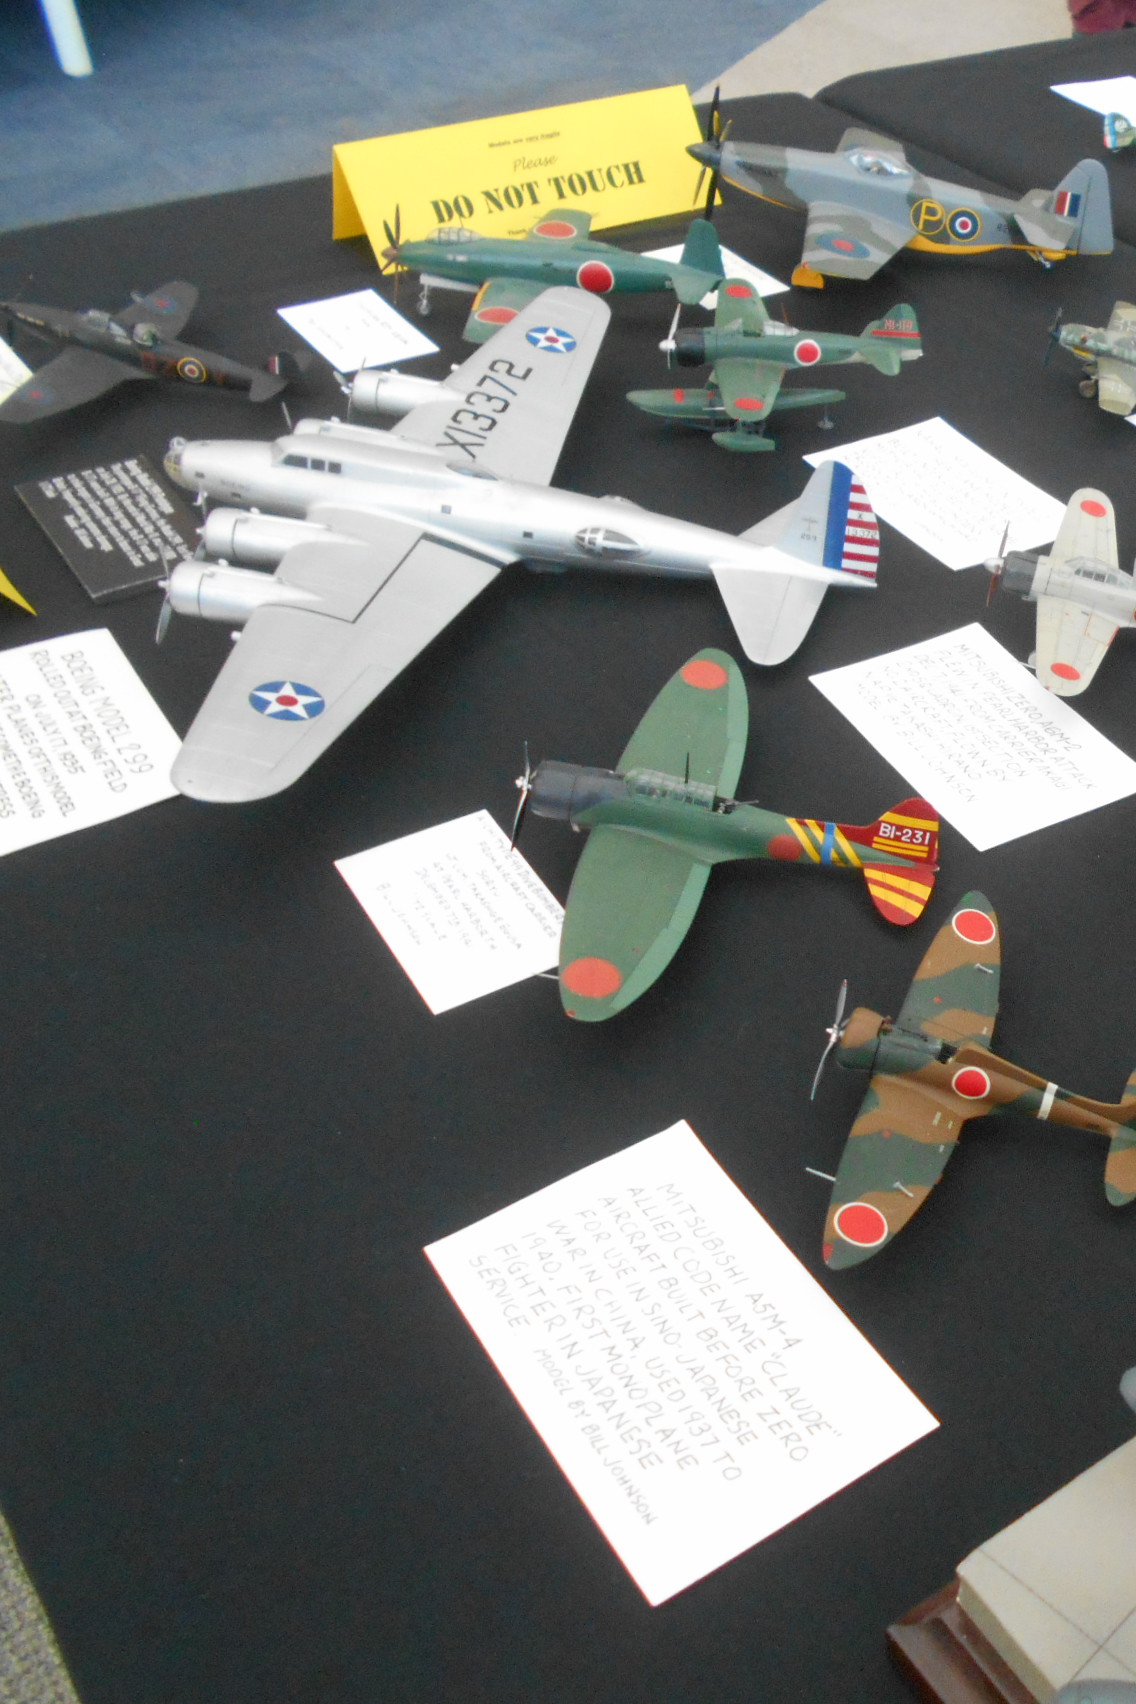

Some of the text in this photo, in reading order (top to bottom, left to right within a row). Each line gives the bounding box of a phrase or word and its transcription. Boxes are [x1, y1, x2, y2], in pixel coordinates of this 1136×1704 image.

[431, 160, 646, 224] DO NOT TOUCH
[512, 154, 558, 172] Please
[918, 201, 944, 231] P
[435, 359, 533, 459] X13372
[3, 703, 40, 747] PLANES
[25, 693, 47, 709] ON
[30, 650, 66, 689] ROLLED
[73, 722, 109, 760] BOEING
[96, 759, 128, 793] FIELD
[34, 711, 62, 736] JULY
[61, 650, 154, 774] BOEING MODEL 299
[58, 751, 86, 775] 1935
[575, 1209, 612, 1244] FOR
[602, 1247, 638, 1281] USE
[625, 1281, 651, 1303] IN
[626, 1187, 683, 1243] ALLIED
[672, 1246, 721, 1297] CODE
[710, 1298, 767, 1355] NAME
[655, 1183, 804, 1351] MITSUBISHI A5M-4
[494, 1242, 664, 1471] FIGHTER IN JAPANESE
[545, 1219, 588, 1263] WAR
[578, 1263, 603, 1284] IN
[644, 1355, 687, 1403] USED
[677, 1404, 721, 1448] 1937
[712, 1450, 743, 1481] TO
[556, 1284, 612, 1340] FIRST
[599, 1344, 700, 1471] MONOPLANE
[597, 1197, 809, 1462] AIRCRAFT BUILT BEFORE ZERO
[532, 1348, 574, 1397] MODEL
[567, 1399, 592, 1419] BY
[580, 1423, 610, 1456] BILL
[602, 1457, 659, 1526] JOHNSON
